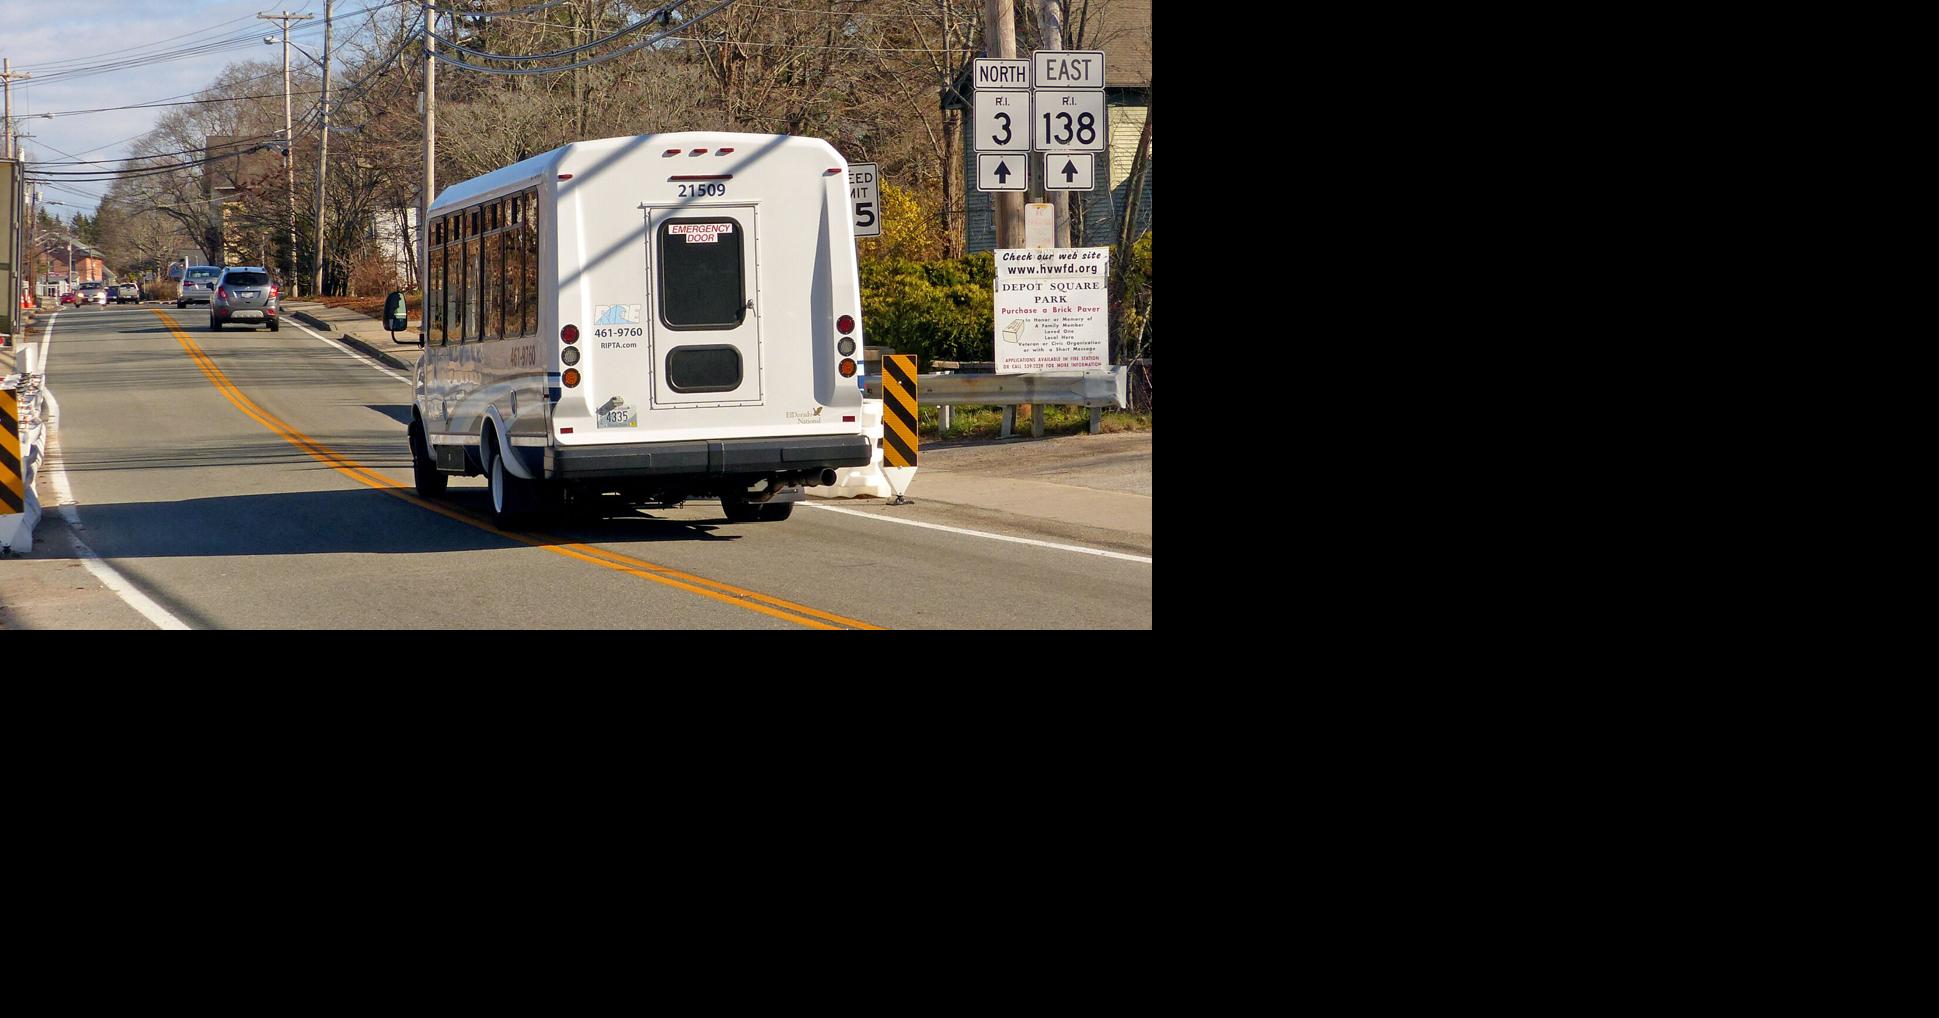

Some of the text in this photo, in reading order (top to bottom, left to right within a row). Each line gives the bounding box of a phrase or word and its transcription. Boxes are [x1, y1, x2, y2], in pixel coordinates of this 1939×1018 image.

[980, 66, 1026, 82] NORTH
[1046, 59, 1092, 81] EAST
[995, 97, 1010, 106] R.I.
[1062, 96, 1077, 106] R.I.
[992, 112, 1012, 145] 3
[1043, 111, 1096, 145] 138
[848, 172, 873, 184] EED
[678, 183, 726, 197] 21509
[855, 202, 875, 227] 5
[672, 224, 731, 234] EMERGENCY
[687, 233, 715, 242] DOOR
[1003, 252, 1032, 260] Check
[1082, 251, 1101, 259] site
[1008, 264, 1097, 274] www.hvwfd.org
[1003, 282, 1100, 292] DEPOT SQUARE
[594, 327, 643, 338] 461-9760
[606, 410, 629, 423] 4335
